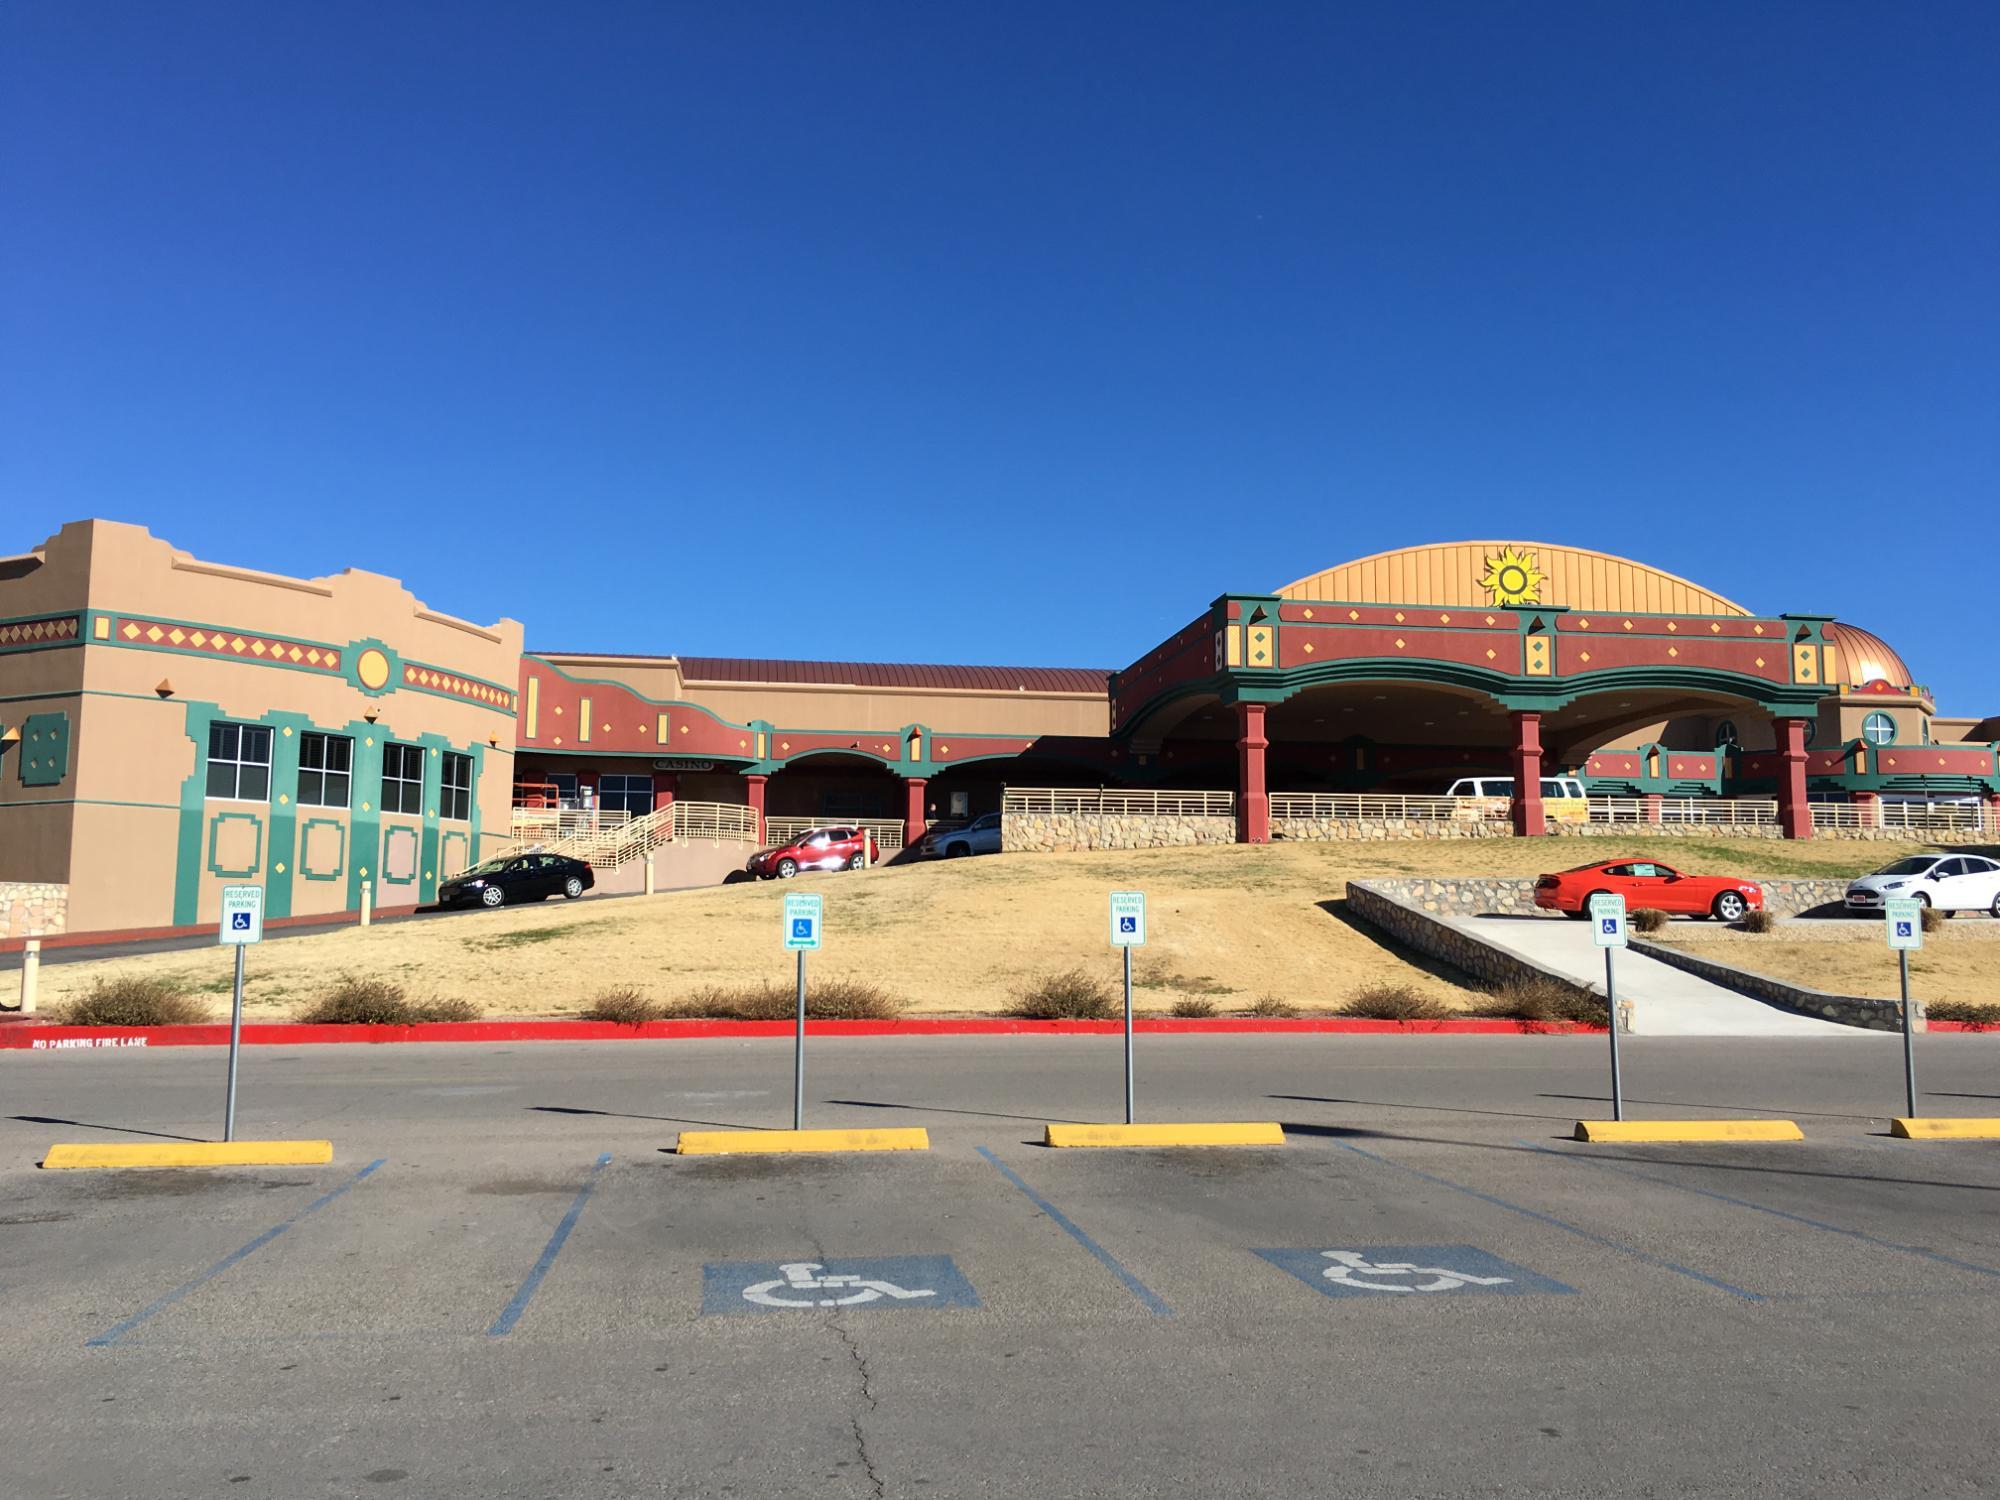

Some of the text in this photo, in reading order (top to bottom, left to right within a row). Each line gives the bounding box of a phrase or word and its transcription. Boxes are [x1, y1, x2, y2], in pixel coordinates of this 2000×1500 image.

[656, 760, 712, 769] CASINO
[225, 890, 260, 898] RESERVED
[229, 900, 256, 908] PARKING
[32, 1036, 148, 1049] NO PARKING FIRE LANE
